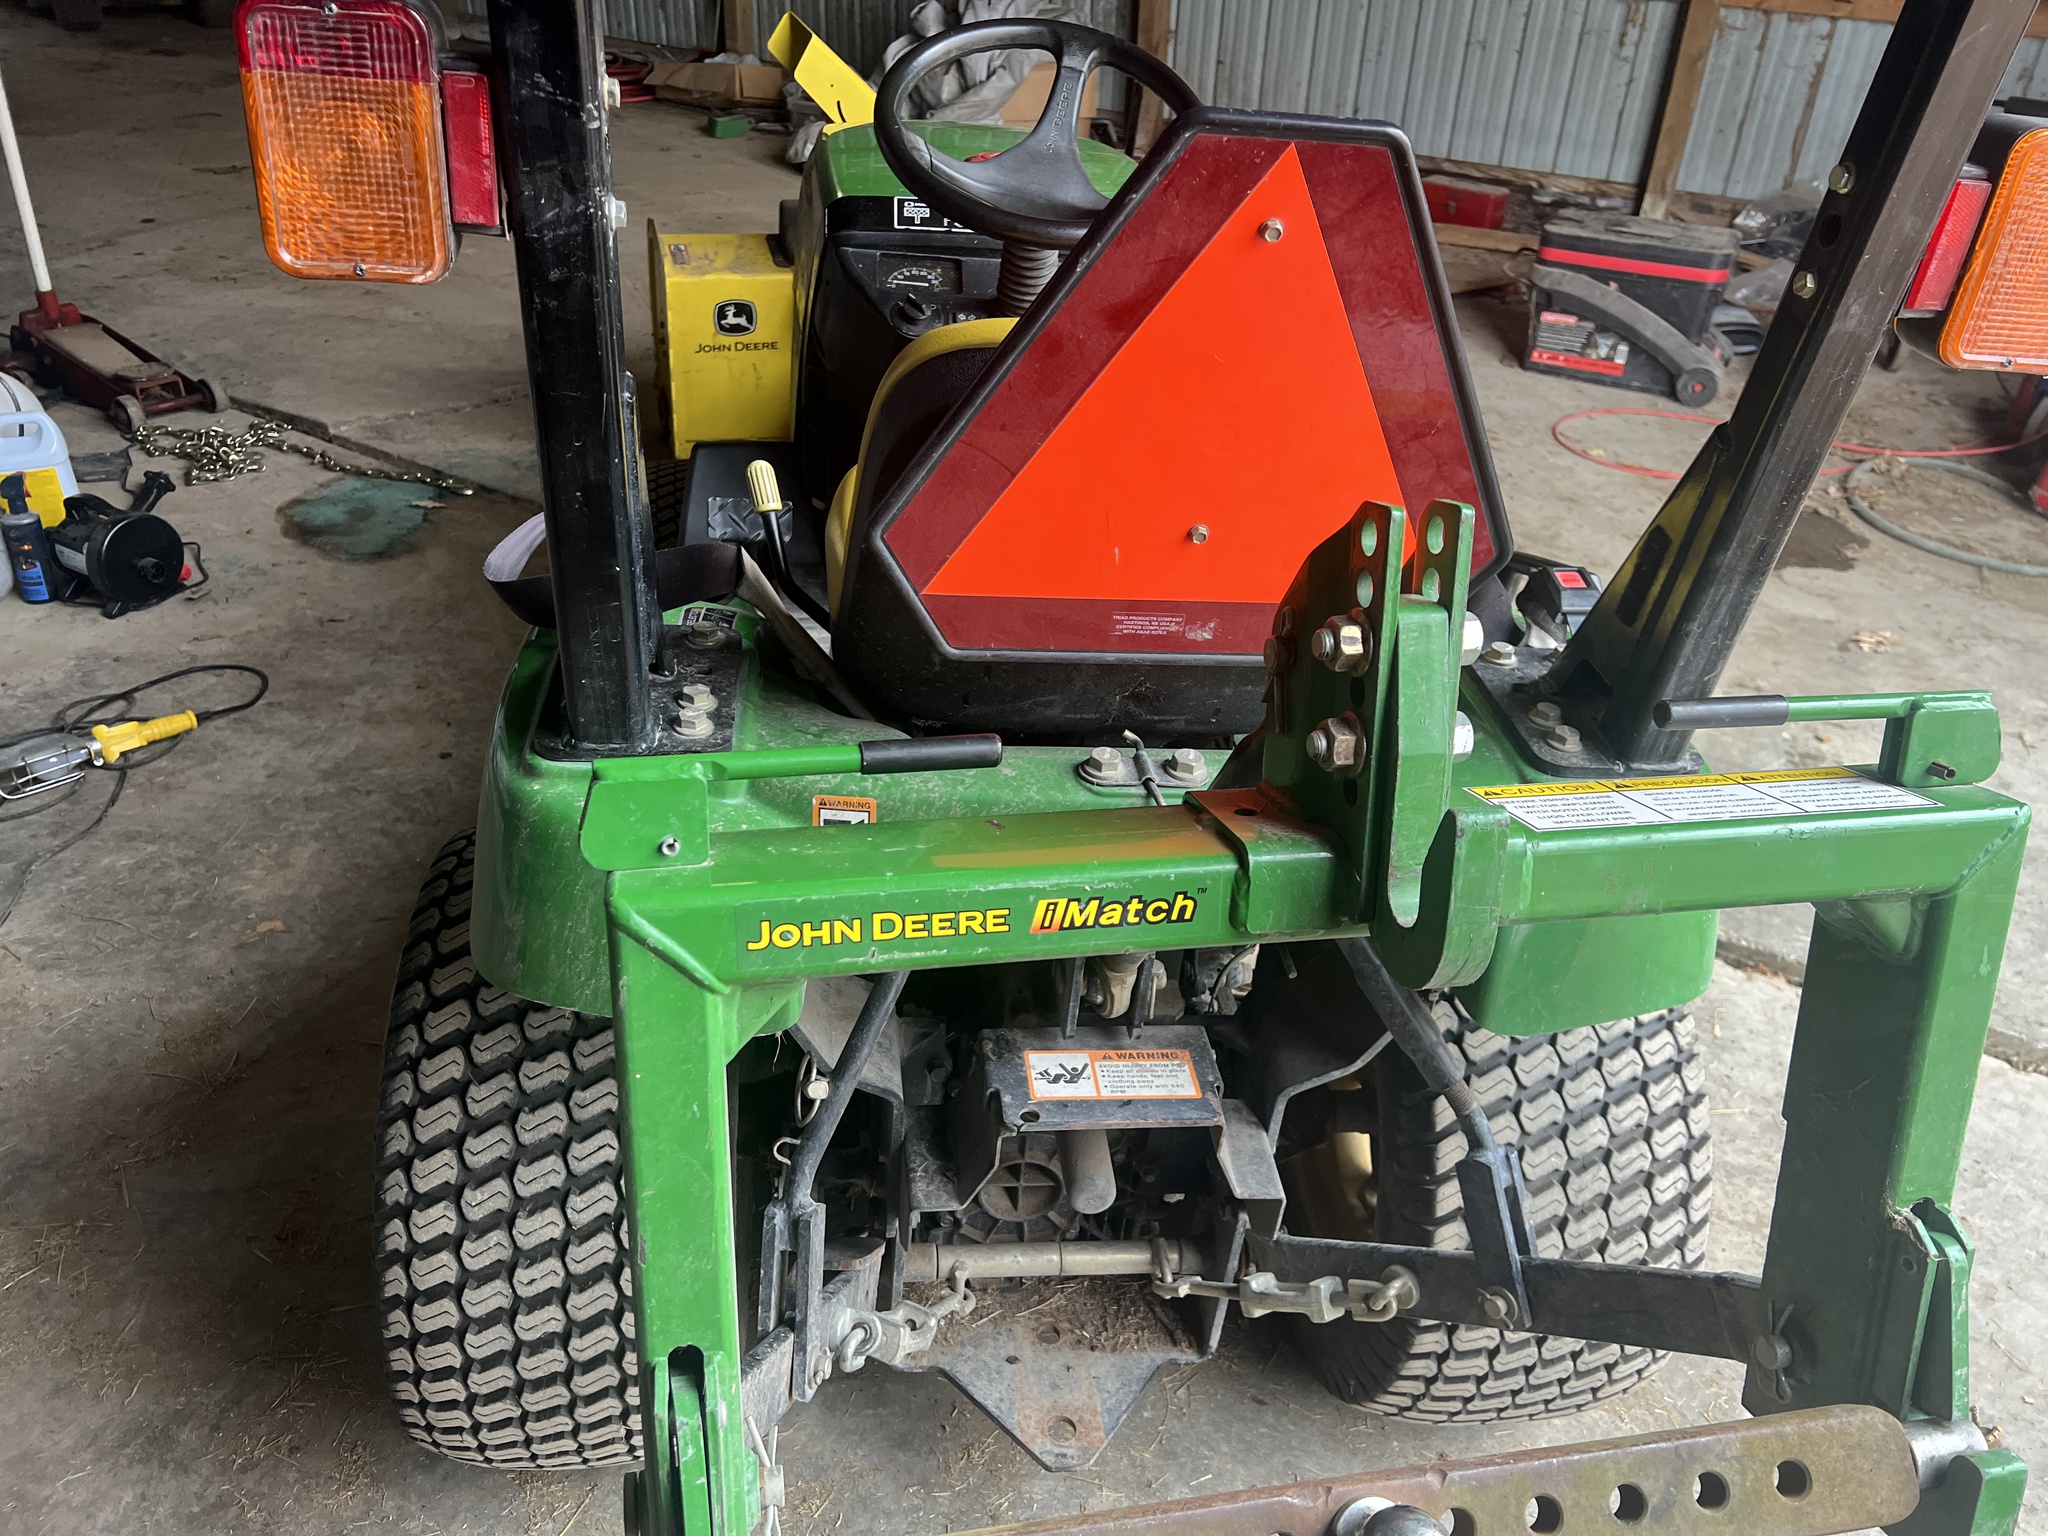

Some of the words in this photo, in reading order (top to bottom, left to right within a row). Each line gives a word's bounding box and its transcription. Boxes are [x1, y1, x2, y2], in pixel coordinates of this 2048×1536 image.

[695, 344, 731, 354] JOHN
[734, 342, 778, 352] DEERE
[1760, 770, 1840, 780] ATTENTION
[1631, 776, 1730, 788] PRECAUCIÓN
[1501, 784, 1596, 796] CAUTION
[828, 800, 870, 809] WARNING
[746, 918, 861, 951] JOHN
[872, 908, 1010, 942] DEERE
[1030, 891, 1198, 934] iMatch
[1116, 1052, 1179, 1060] WARNING
